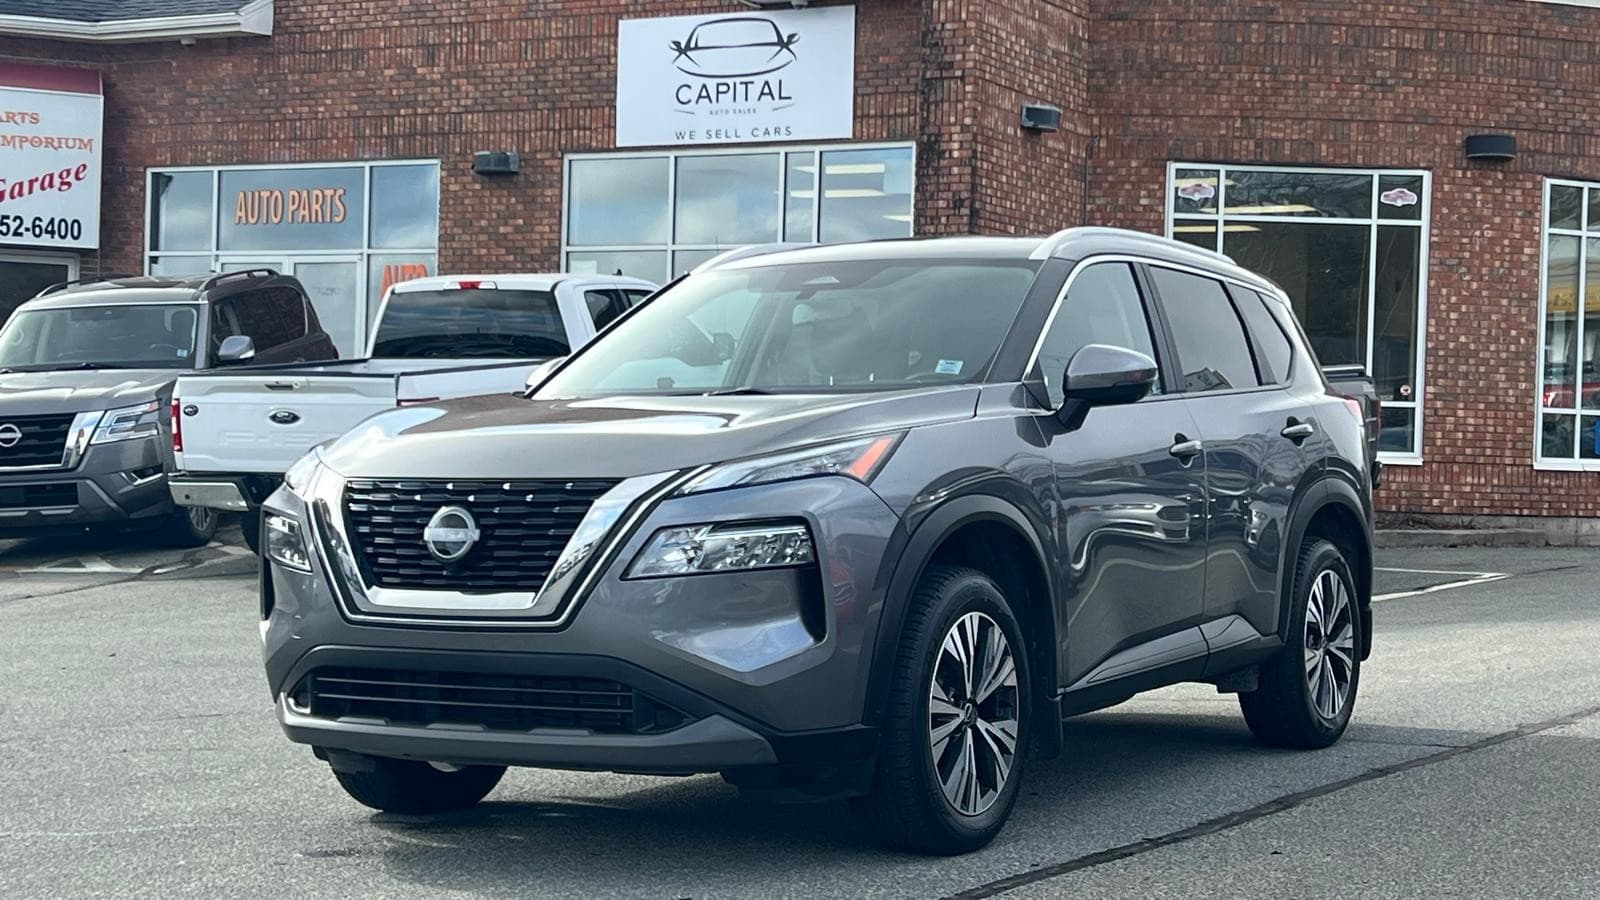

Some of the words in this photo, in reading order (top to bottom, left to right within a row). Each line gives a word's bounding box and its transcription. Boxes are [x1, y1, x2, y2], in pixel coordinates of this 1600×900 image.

[675, 79, 792, 105] CAPITAL
[674, 129, 696, 141] WE
[705, 127, 741, 140] SELL
[751, 125, 792, 138] CARS
[235, 189, 284, 225] AUTO
[288, 187, 347, 224] PARTS
[0, 214, 82, 241] 52-6400
